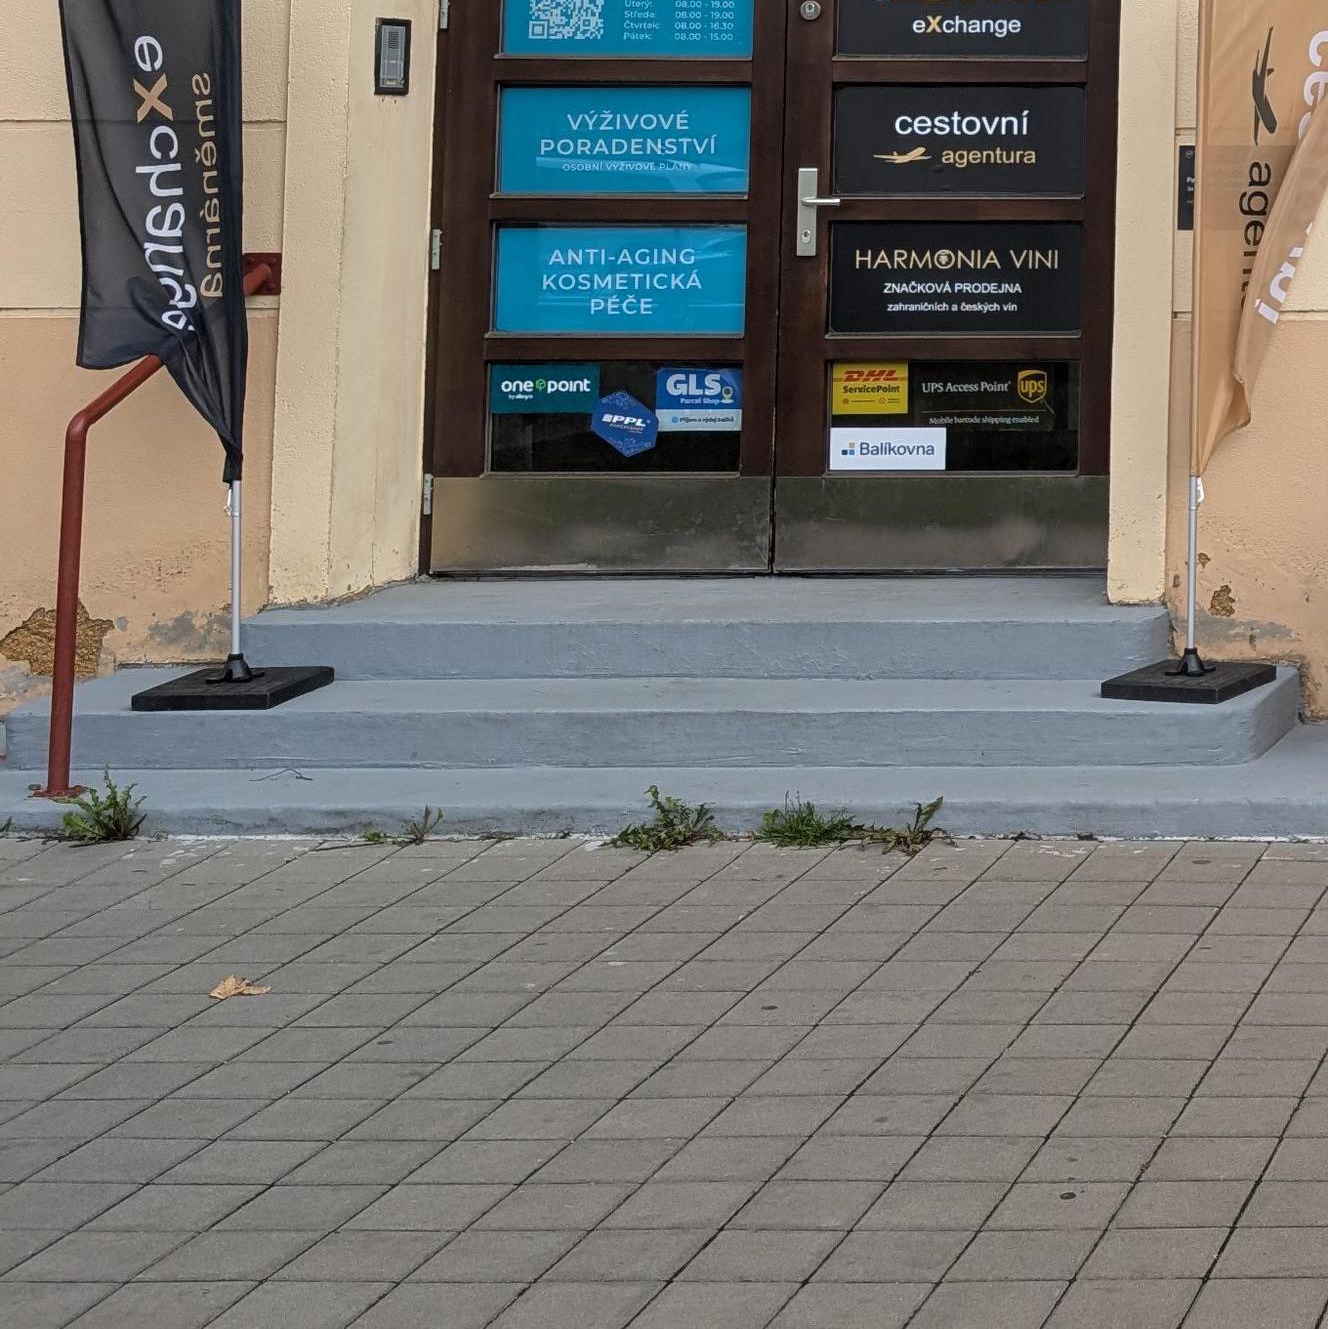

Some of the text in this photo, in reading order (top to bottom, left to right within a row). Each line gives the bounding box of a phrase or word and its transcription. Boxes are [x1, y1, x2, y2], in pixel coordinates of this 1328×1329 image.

[912, 15, 1022, 38] eXchange
[567, 109, 690, 130] VÝŽIVOVÉ
[894, 110, 1030, 136] cestovní
[540, 134, 717, 155] PORADENSTVÍ
[941, 145, 1037, 166] agentura
[548, 248, 696, 267] ANTI-AGING
[855, 249, 1059, 270] HARMONIA VINI
[541, 271, 702, 291] KOSMETICKÁ
[883, 280, 1022, 294] ZNAČKOVÁ PRODEJNA
[590, 295, 654, 316] PÉČE
[951, 304, 958, 312] a
[666, 373, 722, 396] GLS
[843, 370, 899, 382] DHL
[501, 378, 591, 394] one point
[842, 384, 900, 394] ServicePoint
[922, 382, 943, 393] UPS
[945, 381, 979, 393] Access
[612, 414, 646, 427] PPL
[859, 442, 935, 456] Balíkovna
